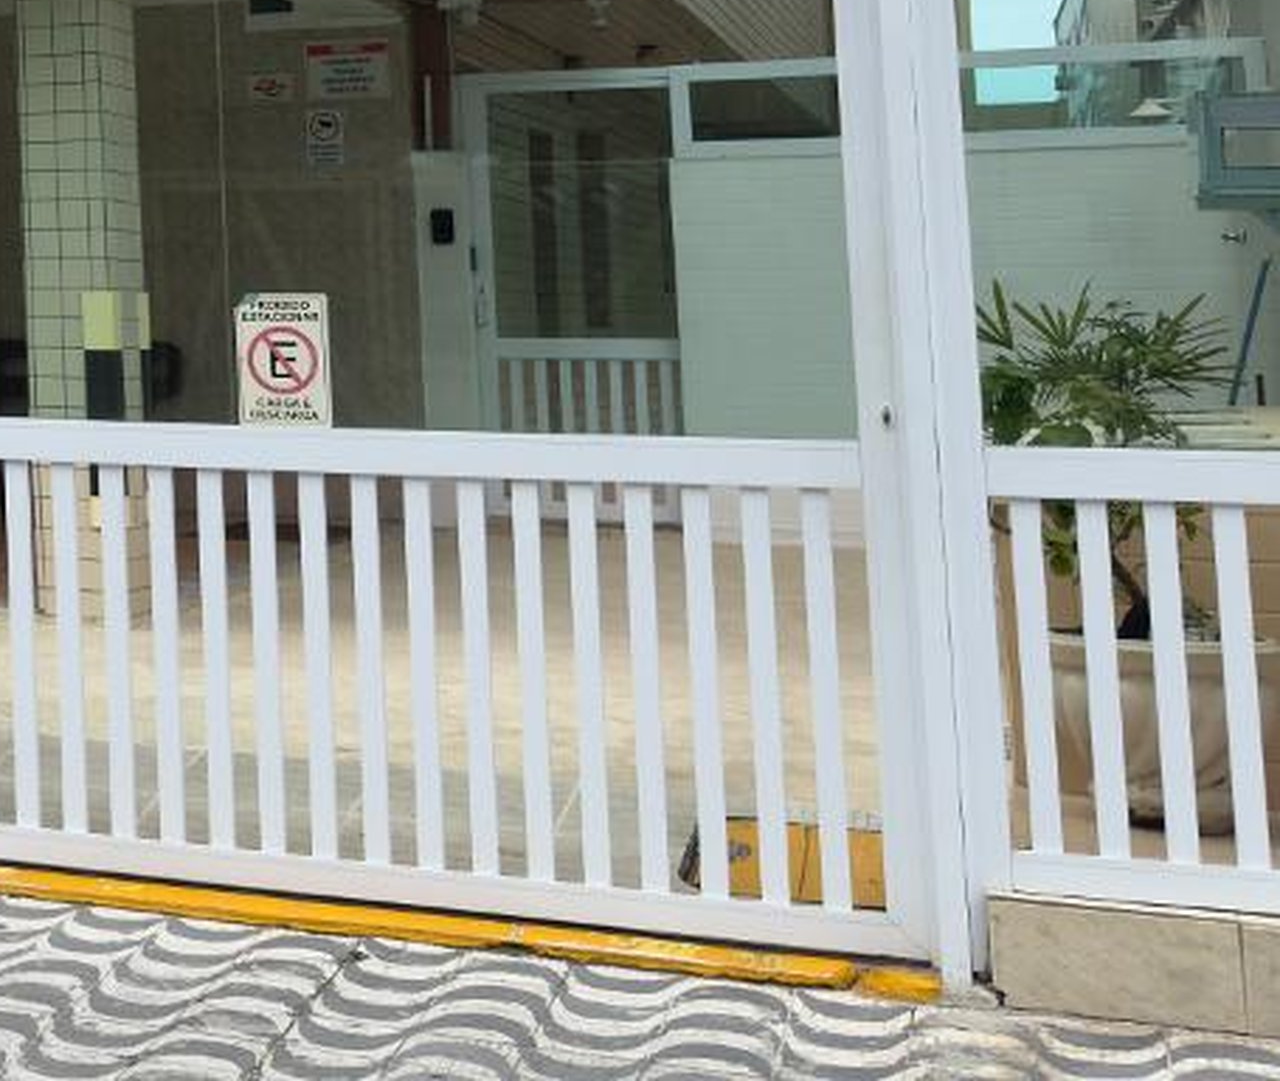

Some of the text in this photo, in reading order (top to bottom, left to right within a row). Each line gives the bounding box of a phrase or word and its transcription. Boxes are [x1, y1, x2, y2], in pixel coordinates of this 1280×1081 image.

[248, 300, 310, 311] PROIBIDO
[241, 312, 319, 322] ESTACIONAR
[269, 340, 297, 379] E
